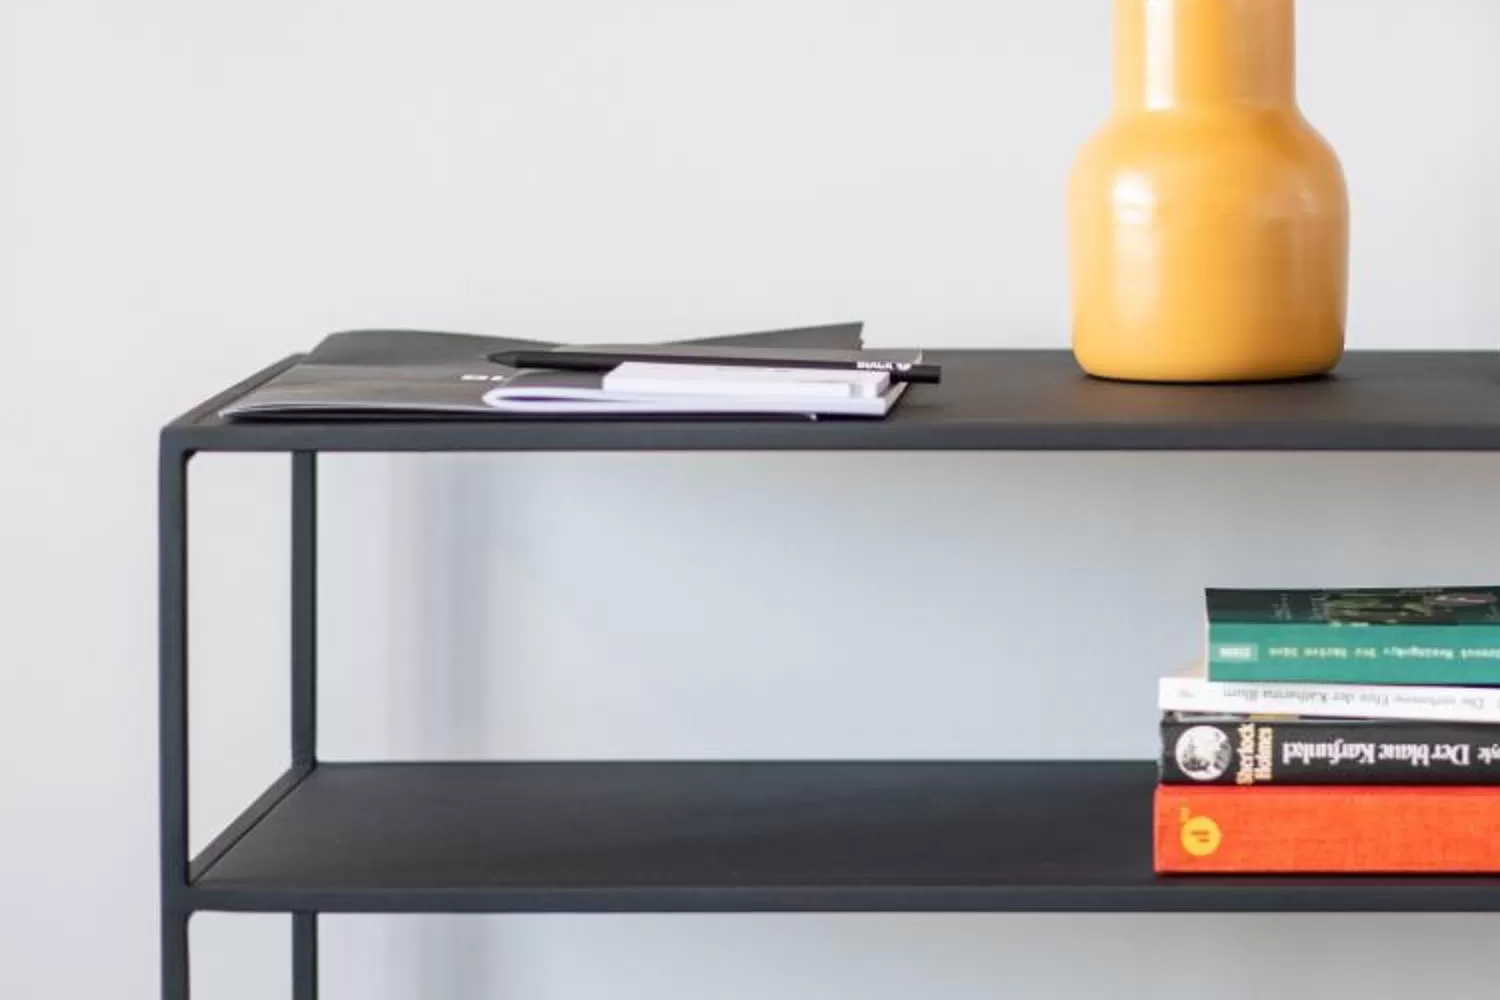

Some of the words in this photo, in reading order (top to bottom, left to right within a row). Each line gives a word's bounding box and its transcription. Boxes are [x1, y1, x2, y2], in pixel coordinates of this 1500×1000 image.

[1235, 722, 1255, 785] Sherlock
[1282, 738, 1376, 766] Karfunkel
[1378, 743, 1430, 767] blaue
[1430, 743, 1471, 766] Der
